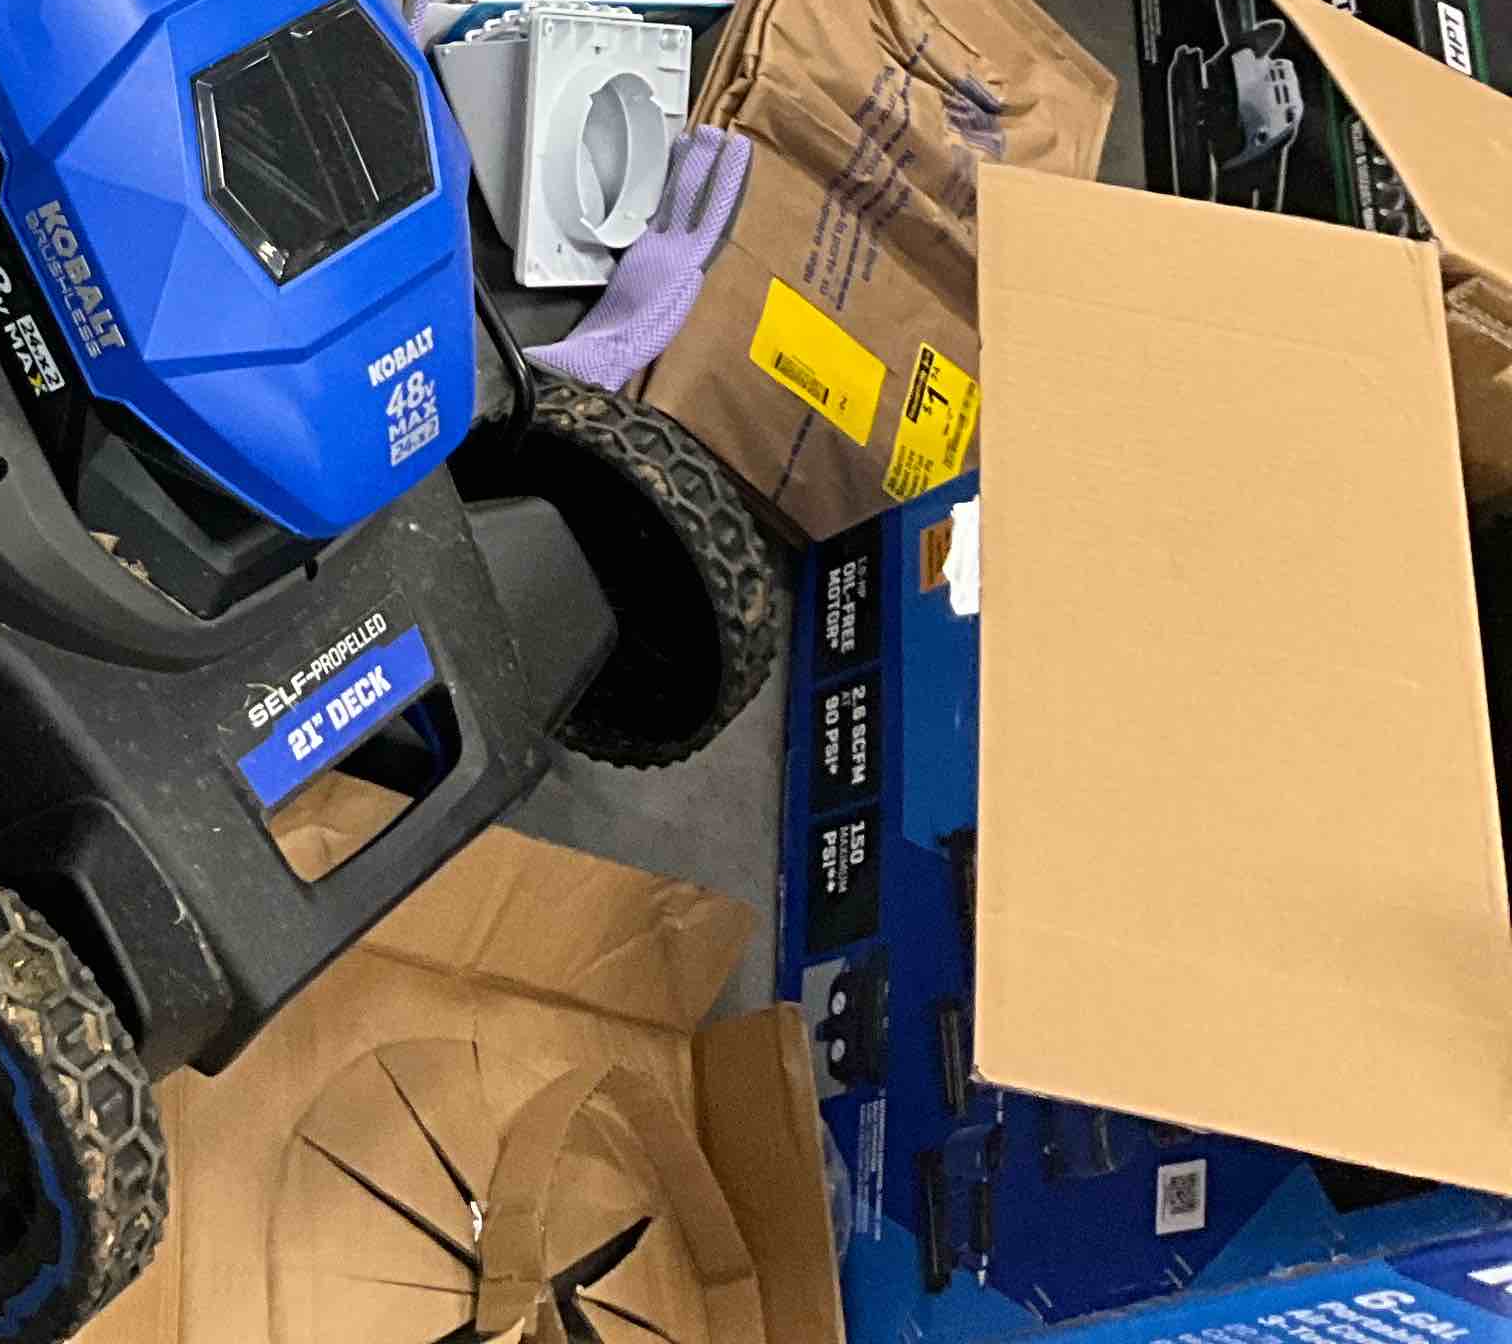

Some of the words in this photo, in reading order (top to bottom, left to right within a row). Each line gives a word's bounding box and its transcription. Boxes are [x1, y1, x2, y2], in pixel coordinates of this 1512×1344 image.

[1441, 6, 1467, 71] HPT
[27, 211, 99, 359] BRUSHLESS
[37, 199, 126, 350] KOBALT
[3, 322, 47, 398] MAX
[369, 326, 434, 387] KOBALT
[388, 399, 439, 443] MAX
[840, 561, 855, 652] OIL-FREE
[245, 611, 388, 728] SELF-PROPELLED
[283, 711, 324, 761] 21"
[323, 664, 390, 731] DECK
[824, 695, 840, 725] 90
[850, 722, 867, 784] SCFM
[837, 825, 849, 893] MAXIMUM
[849, 820, 864, 864] 150
